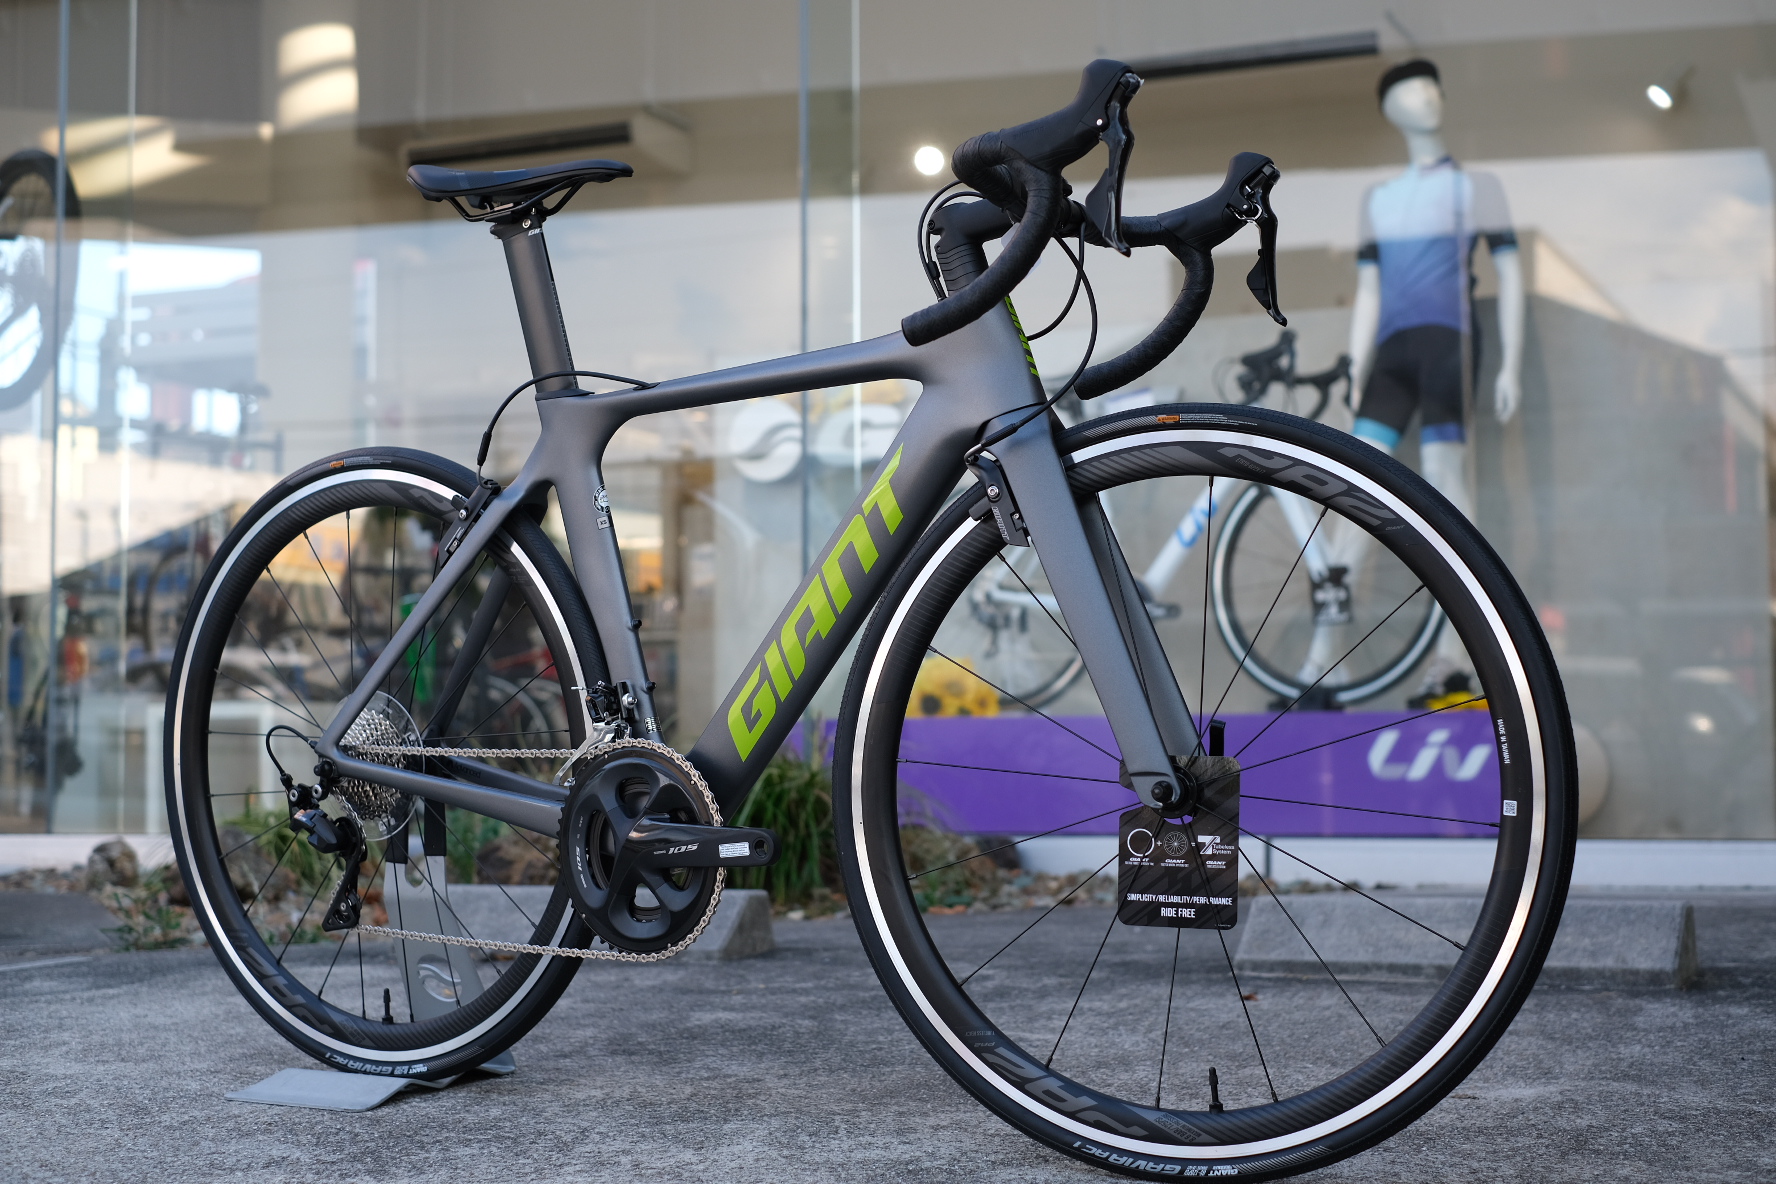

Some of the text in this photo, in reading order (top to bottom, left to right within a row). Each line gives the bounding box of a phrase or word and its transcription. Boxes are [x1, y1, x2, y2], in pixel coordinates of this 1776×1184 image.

[728, 442, 904, 763] GIANT
[1497, 716, 1506, 735] MADE
[1367, 728, 1493, 782] Liv
[1501, 742, 1511, 764] TAIWAN
[667, 842, 700, 855] 105
[1160, 907, 1196, 918] RIDE FREE
[347, 1060, 393, 1075] GAVIA
[1081, 1144, 1111, 1158] AC
[1108, 1154, 1182, 1175] GAVIA
